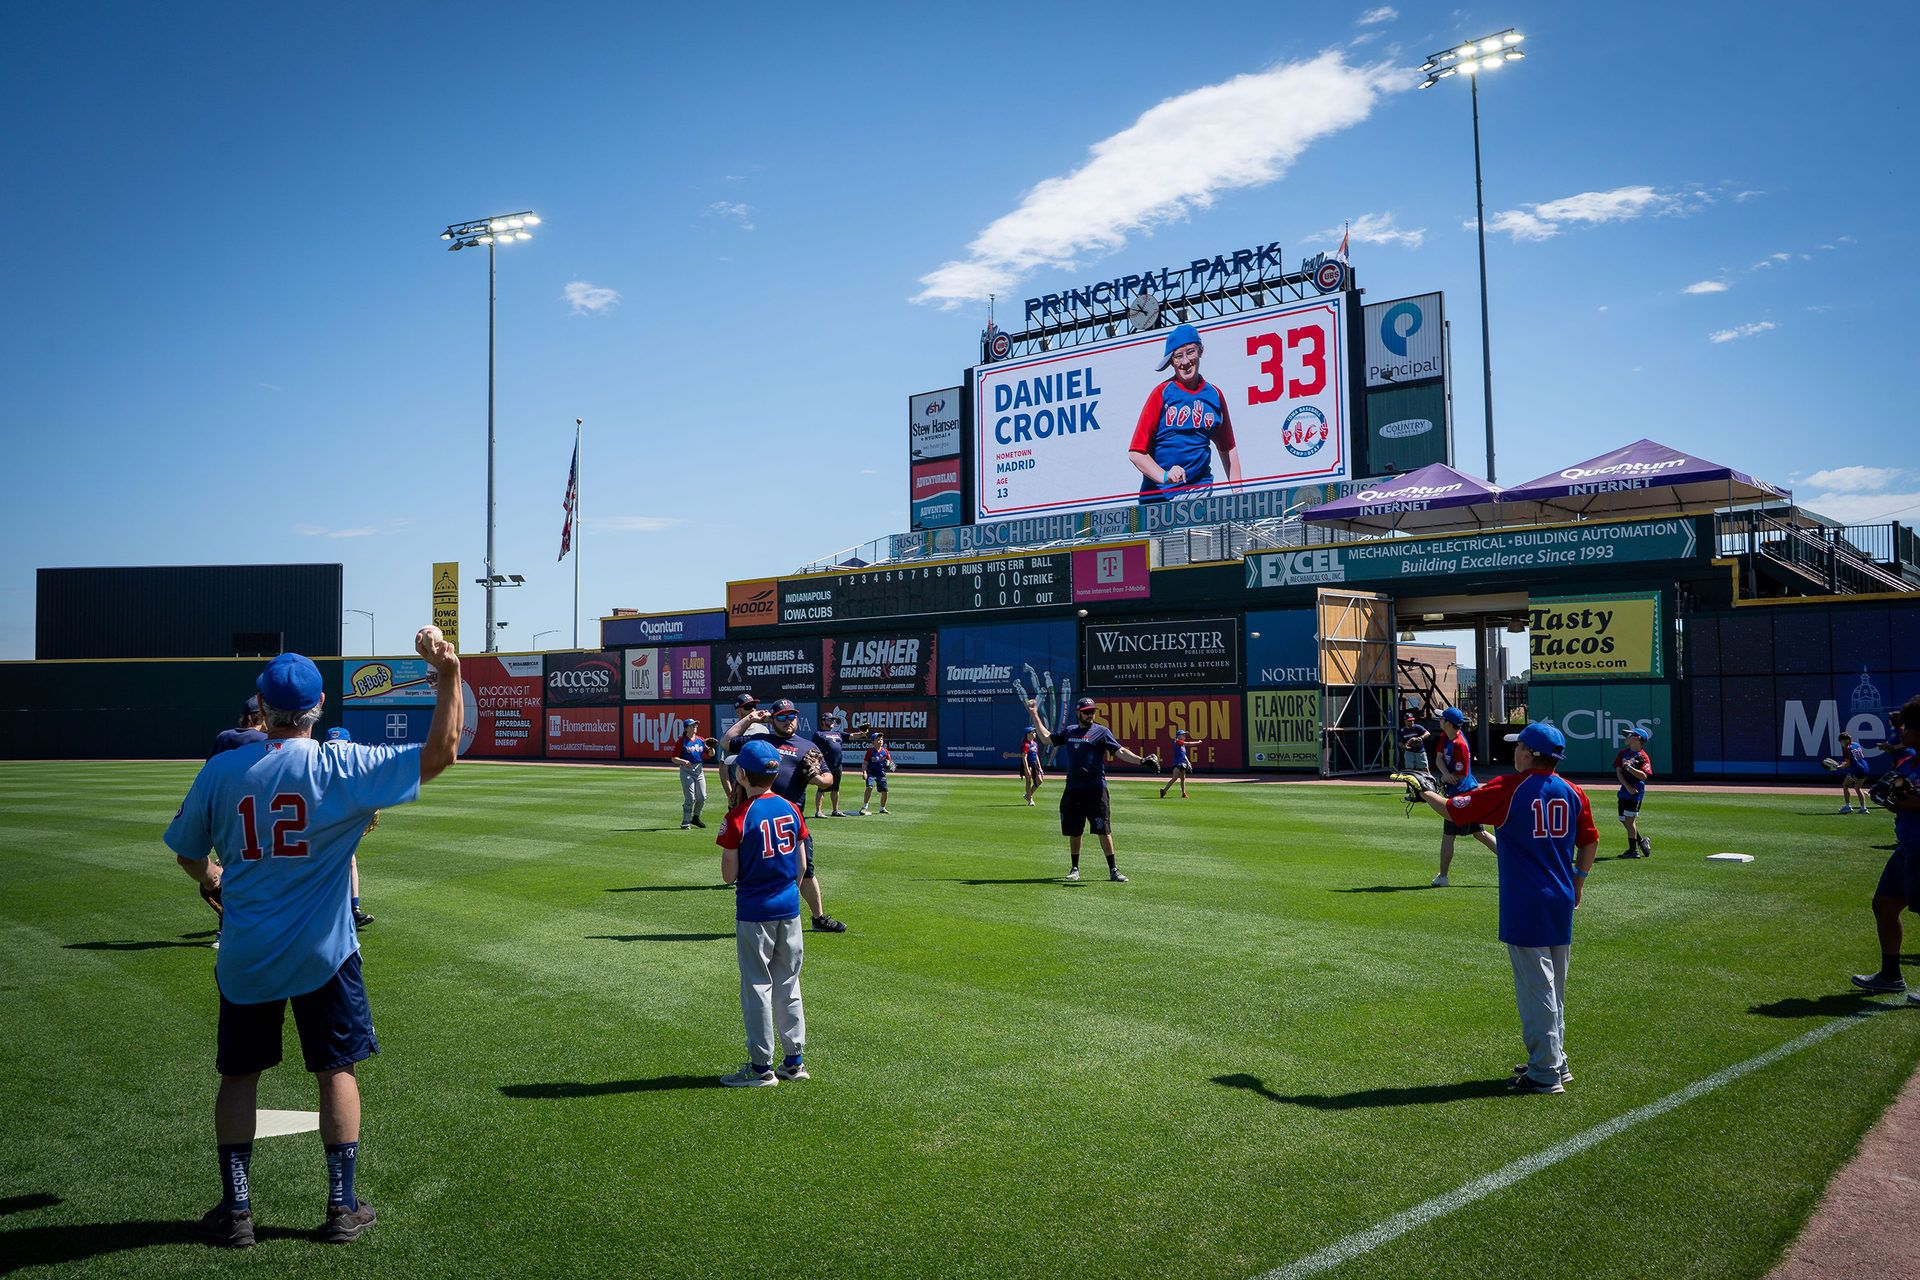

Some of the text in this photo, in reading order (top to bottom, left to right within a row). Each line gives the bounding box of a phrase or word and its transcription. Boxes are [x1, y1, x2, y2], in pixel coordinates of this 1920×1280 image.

[1024, 241, 1280, 321] PRINCIPAL PARK
[1246, 324, 1327, 406] 33
[1370, 360, 1438, 381] Principal
[994, 367, 1101, 413] DANIEL
[912, 422, 930, 437] Stew
[994, 400, 1101, 445] CRONK
[1386, 421, 1426, 433] COUNTRY
[996, 449, 1032, 460] HOMETOWN
[997, 459, 1036, 474] MADRID
[1560, 458, 1686, 480] Quantum
[996, 478, 1008, 486] AGE
[1568, 477, 1653, 496] INTERNET
[997, 488, 1009, 498] 13
[1356, 482, 1463, 502] Quantum
[920, 503, 954, 518] ADVENTURE
[1146, 490, 1288, 531] BUSCHHHHH
[1359, 500, 1431, 516] INTERNET
[1092, 511, 1129, 527] BUSCH
[960, 514, 1076, 550] BUSCHHHHH
[894, 532, 925, 551] BUSCH
[1349, 522, 1677, 560] MECHANICAL ELECTRICAL BUILDING AUTOMATION
[1103, 557, 1118, 578] T
[1401, 544, 1614, 574] Building Excellence Since 1993
[838, 556, 1053, 586] 1 2 3 4 5 6 7 8 9 10 RUNS HITS ERR BALL
[1262, 549, 1345, 588] EXCEL
[785, 571, 1054, 603] INDIANAPOLIS 0 0 0 STRIKE
[1289, 573, 1320, 584] MECHANICAL
[1091, 587, 1112, 595] internet
[1125, 584, 1146, 592] T-Mobile
[434, 607, 457, 618] Iowa
[731, 601, 774, 615] HOODZ
[785, 609, 807, 621] IOWA
[808, 606, 833, 618] CUBS
[975, 593, 981, 608] 0
[1000, 591, 1006, 606] 0
[1014, 589, 1020, 604] 0
[1036, 592, 1054, 604] OUT
[434, 617, 457, 627] State
[640, 620, 683, 637] Quantum
[1528, 608, 1613, 635] Tasty
[442, 627, 457, 636] ank
[1096, 631, 1225, 653] WINCHESTER
[1530, 634, 1615, 657] Tacos
[682, 657, 705, 670] FLAVOR
[746, 649, 804, 662] PLUMBERS &
[1198, 660, 1231, 668] KITCHEN
[746, 663, 815, 676] STEAMFITTERS
[947, 664, 1011, 682] Tompkins
[1532, 659, 1627, 672] stytacos.com
[550, 670, 610, 688] access
[631, 669, 650, 690] LOLA'S
[682, 670, 705, 679] RUNS
[691, 679, 705, 687] THE
[479, 685, 530, 696] KNOCKING IT
[682, 686, 705, 695] FAMILY
[947, 688, 977, 696] HYDRAULIC
[479, 697, 541, 708] OUT OF THE PARK
[1255, 694, 1317, 718] FLAVOR'S
[495, 710, 522, 718] RELIABLE,
[851, 711, 928, 729] CEMENTECH
[1094, 700, 1231, 740] SIMPSON
[495, 720, 532, 729] AFFORDABLE,
[562, 719, 617, 732] Homemakers
[1255, 719, 1317, 743] WAITING.
[1562, 709, 1654, 749] Clips
[1781, 700, 1887, 758] Me
[495, 730, 529, 738] RENEWABLE
[495, 739, 518, 747] ENERGY
[888, 741, 925, 749] Mixer Trucks
[1292, 752, 1318, 760] PORK
[237, 792, 310, 861] 12
[1531, 798, 1569, 838] 10
[760, 814, 796, 859] 15
